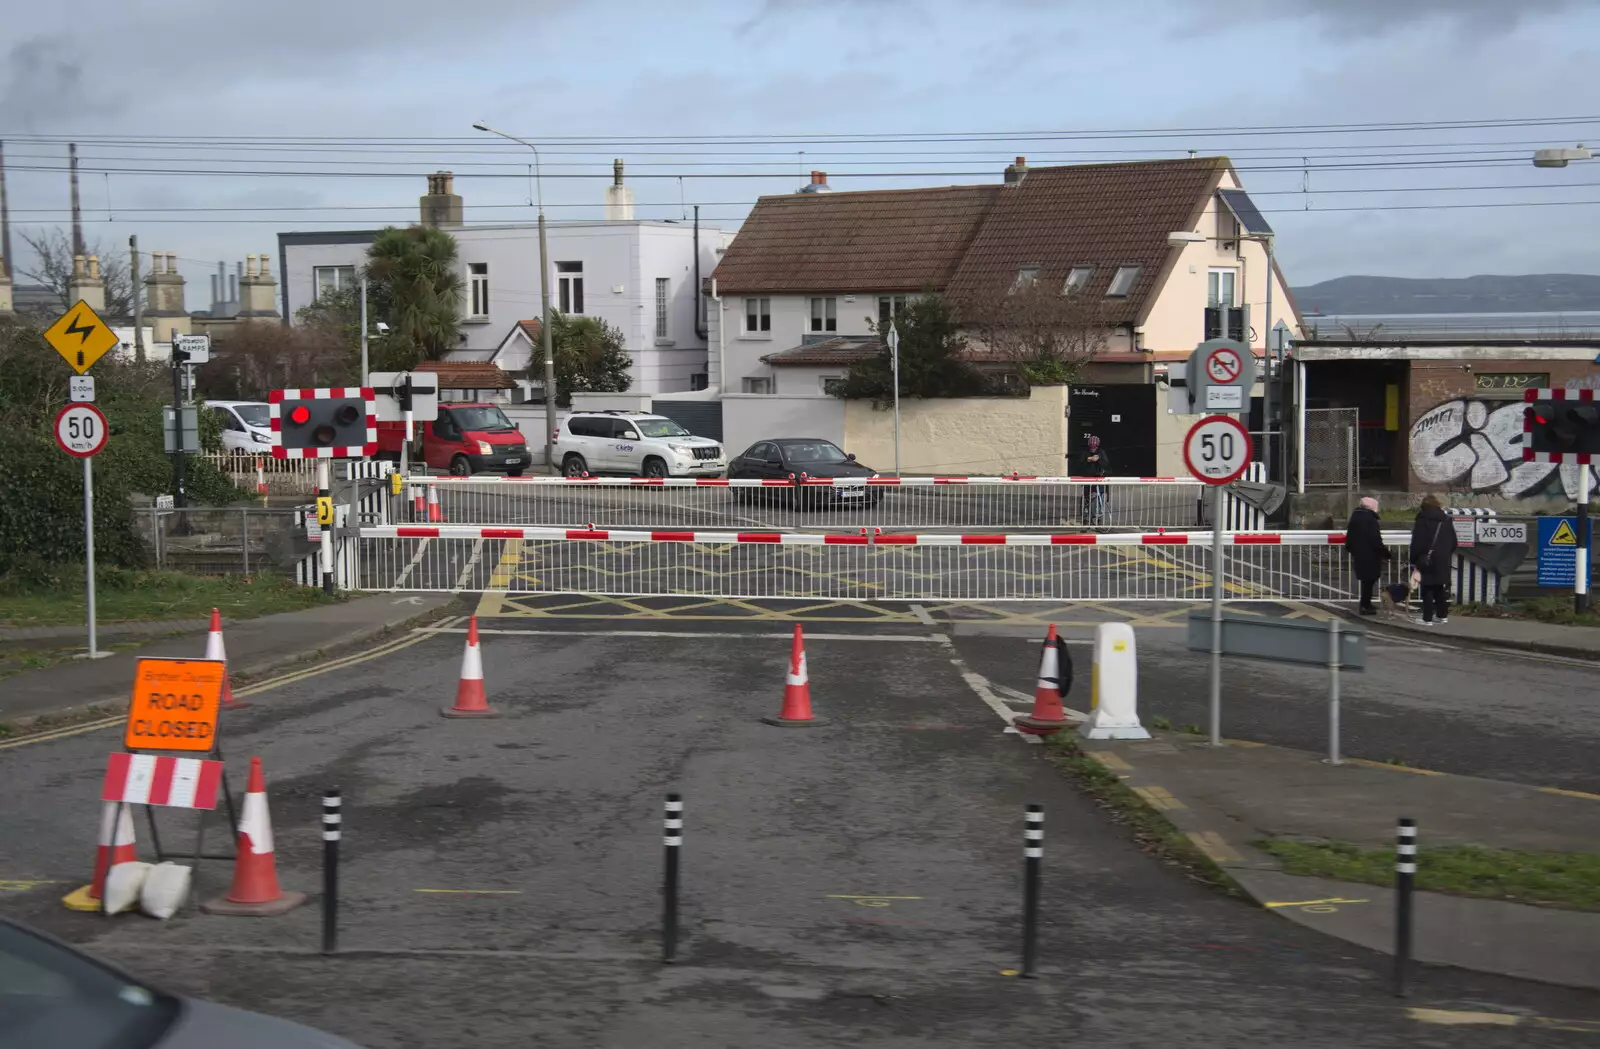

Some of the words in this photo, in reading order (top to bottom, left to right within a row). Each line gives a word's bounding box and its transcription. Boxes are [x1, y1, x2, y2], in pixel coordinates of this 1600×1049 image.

[68, 416, 94, 439] 50
[71, 442, 93, 450] km/h
[1201, 432, 1234, 462] 50
[1204, 465, 1231, 474] km/h
[1482, 527, 1497, 538] XR
[1501, 527, 1523, 538] 005
[148, 692, 203, 711] ROAD
[133, 719, 212, 739] CLOSED
